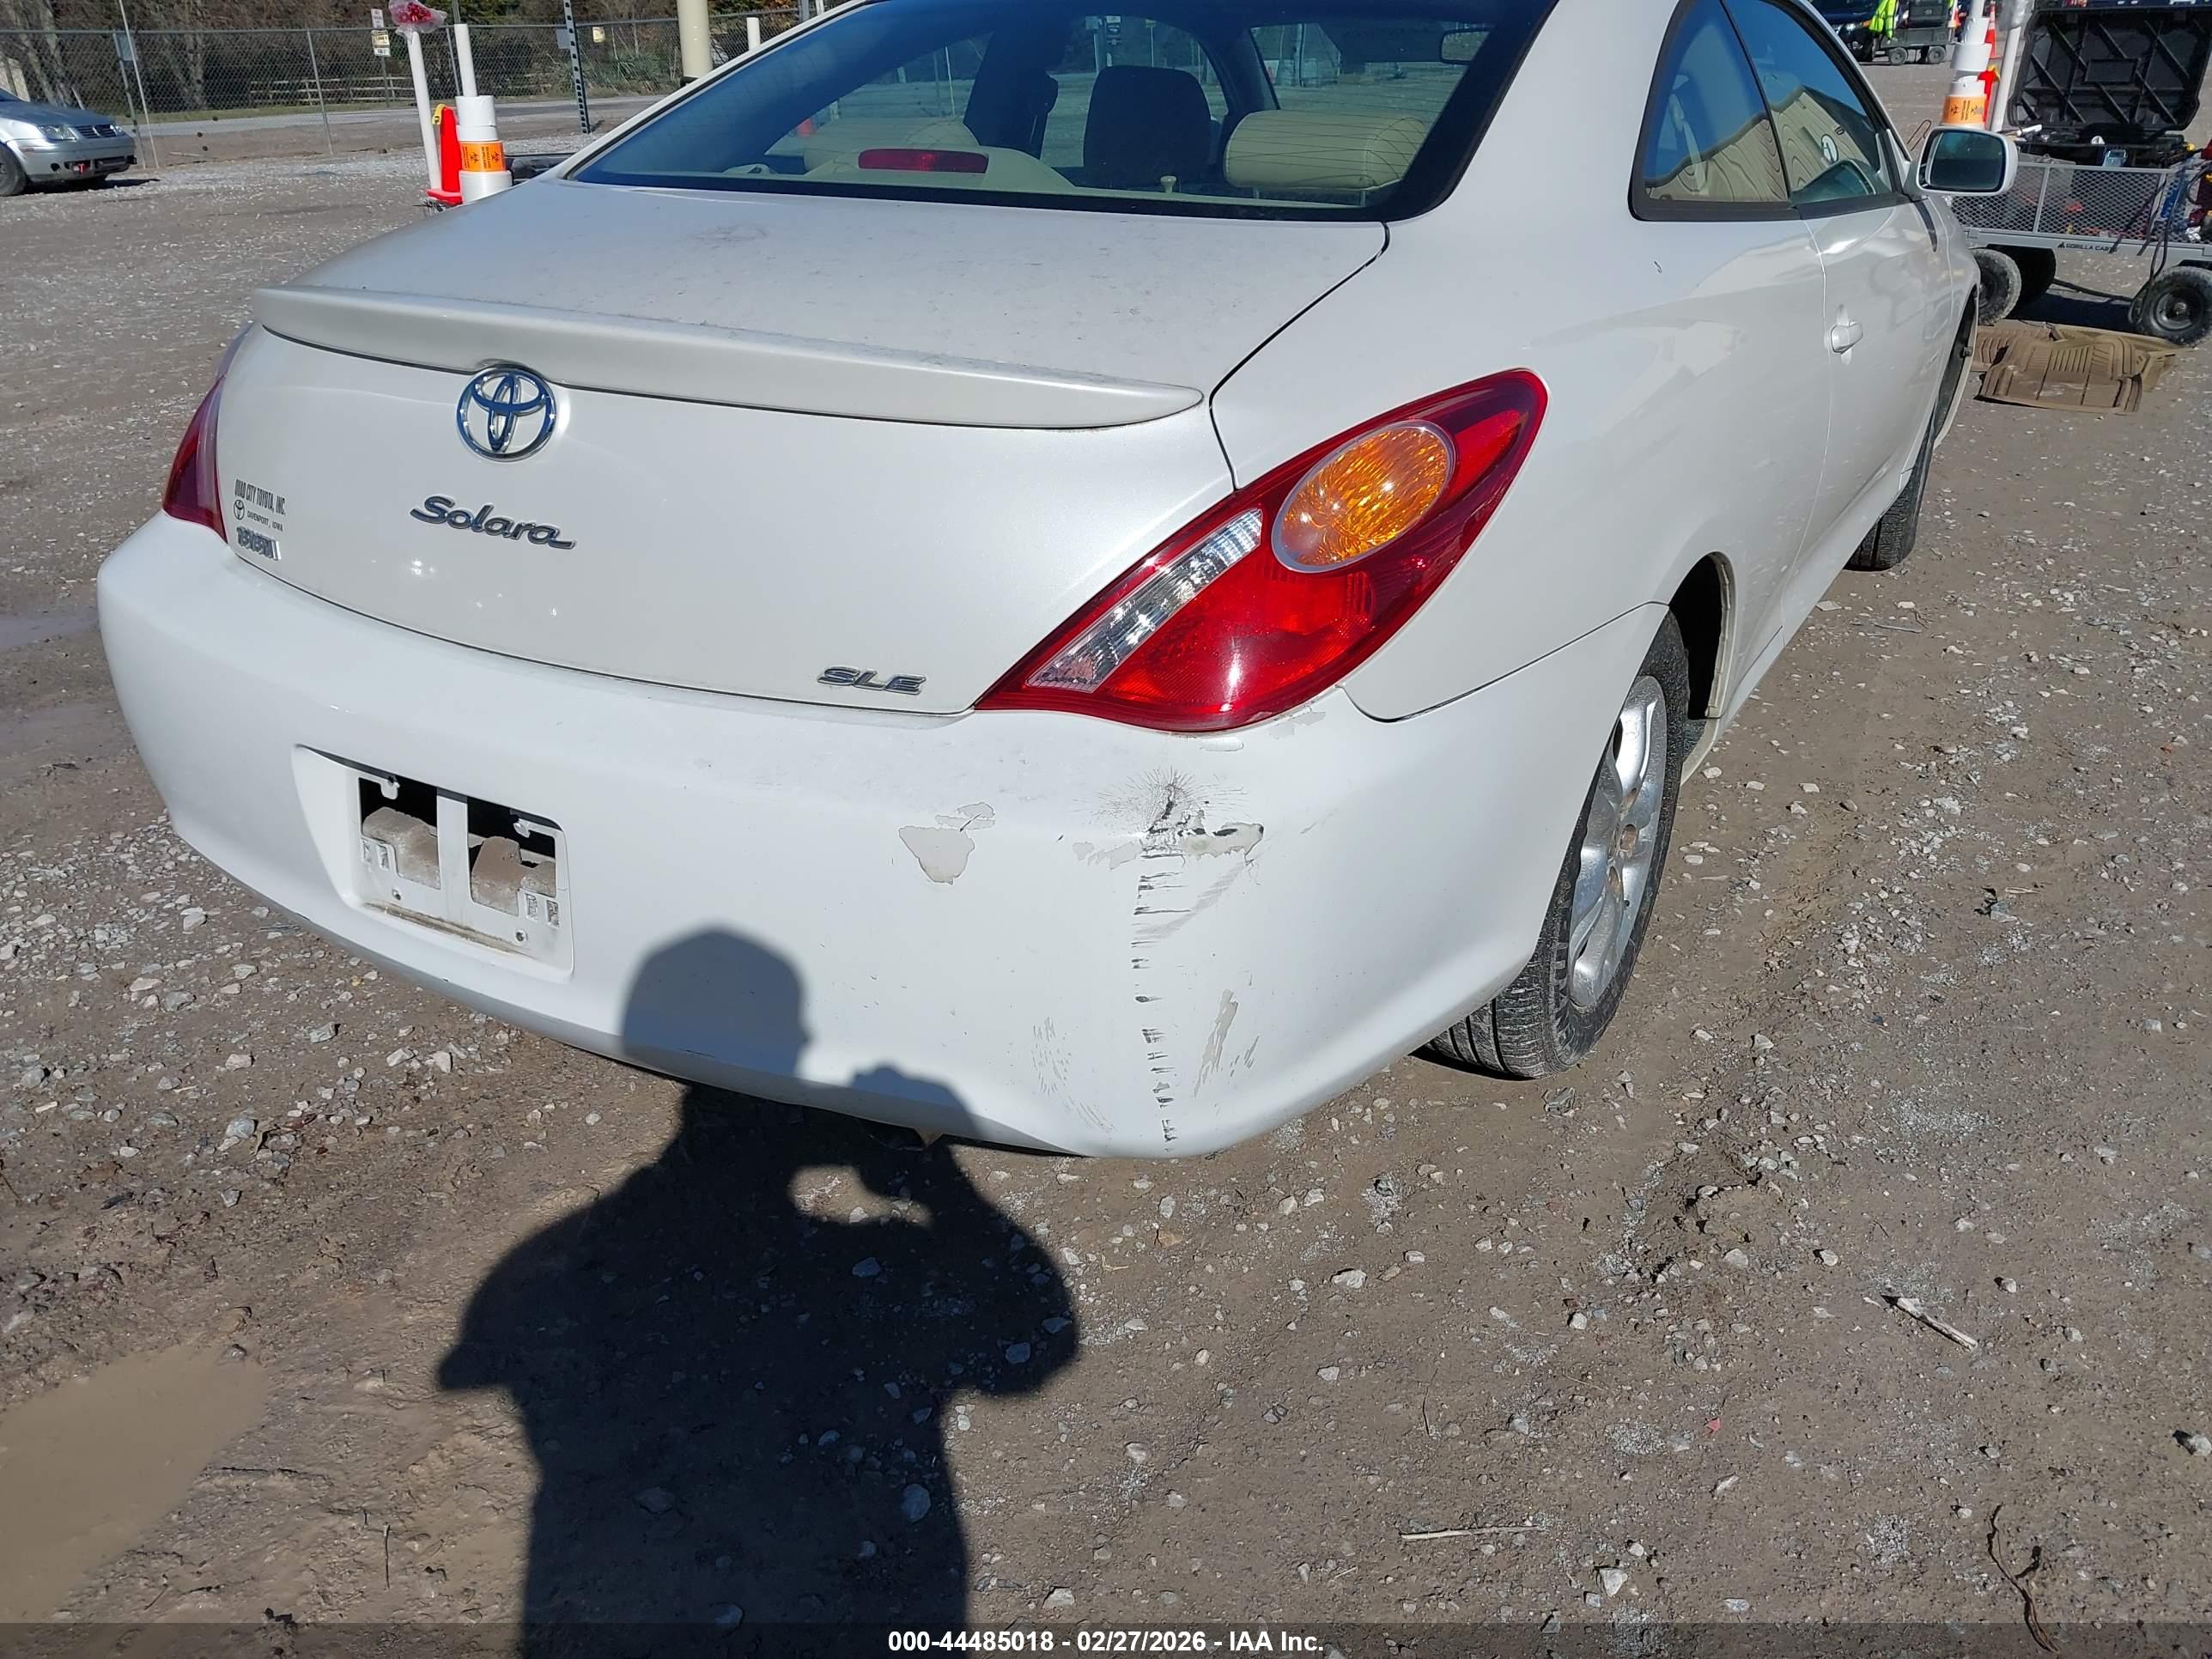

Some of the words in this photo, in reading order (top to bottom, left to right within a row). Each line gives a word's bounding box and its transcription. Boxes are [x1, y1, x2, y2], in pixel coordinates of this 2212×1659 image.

[246, 483, 257, 503] CITY
[276, 495, 286, 516] INC.
[410, 495, 576, 550] Solara
[817, 666, 927, 696] SLE
